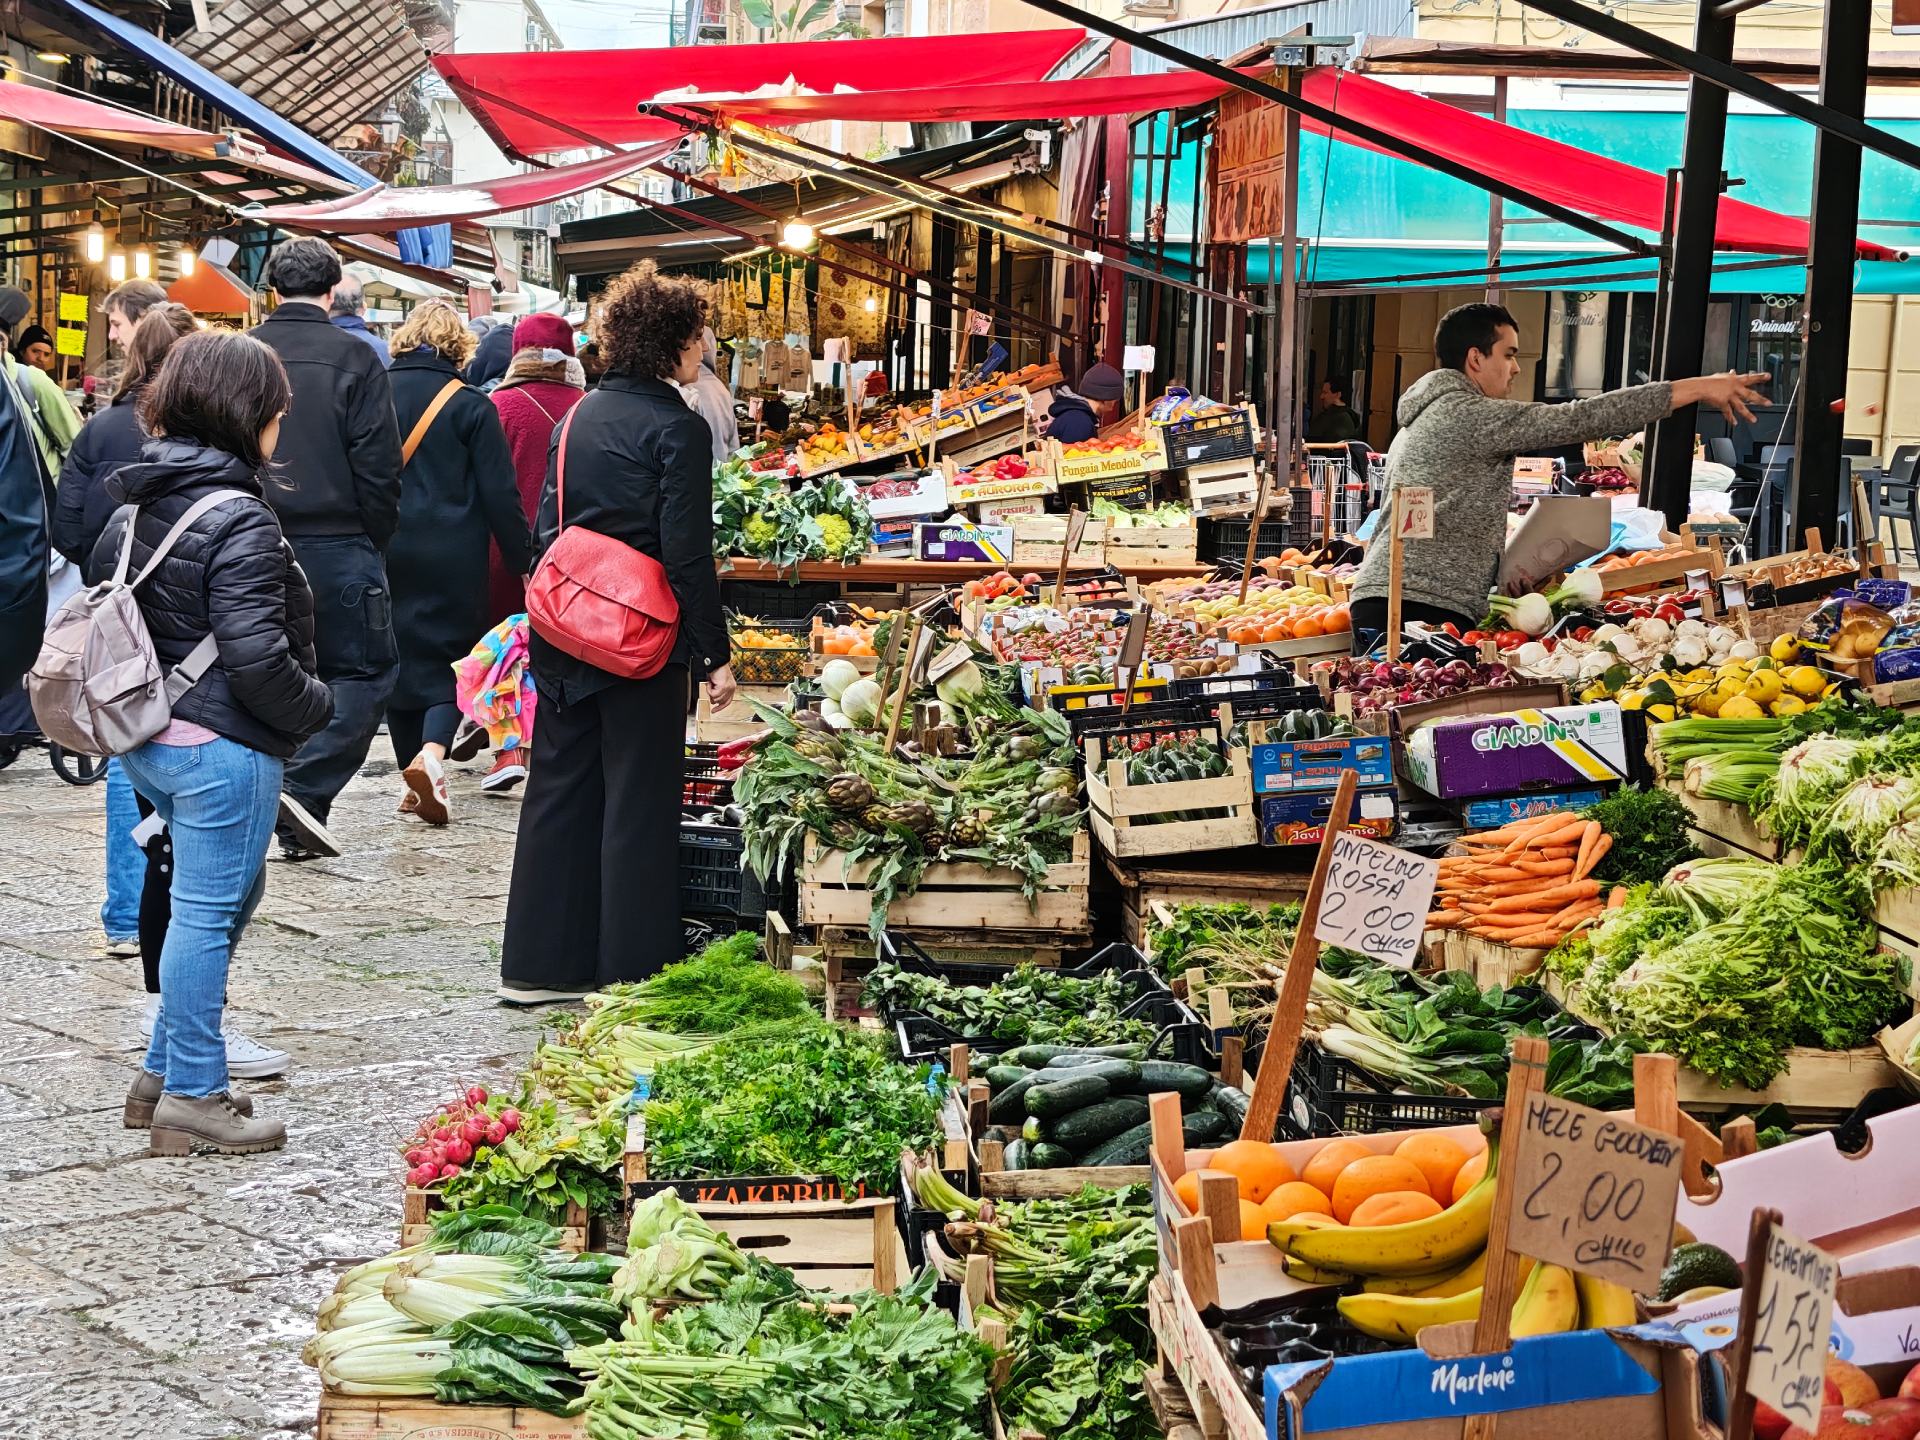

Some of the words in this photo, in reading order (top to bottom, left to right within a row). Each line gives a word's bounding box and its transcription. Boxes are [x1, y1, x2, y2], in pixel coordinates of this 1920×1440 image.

[1062, 462, 1099, 477] Fungaia
[1101, 457, 1141, 472] Mendola
[977, 482, 1031, 497] AURORA
[1293, 830, 1320, 840] Javi
[1326, 862, 1405, 900] ROSSA
[1320, 891, 1415, 942] 2,00
[1527, 1100, 1586, 1142] MELE
[1595, 1121, 1681, 1168] GOLDEN
[1523, 1151, 1645, 1239] 2,00
[1575, 1234, 1646, 1273] CHILO
[1753, 1281, 1820, 1382] 1,59
[1431, 1361, 1515, 1406] Marlene
[444, 1428, 486, 1438] PRECISA
